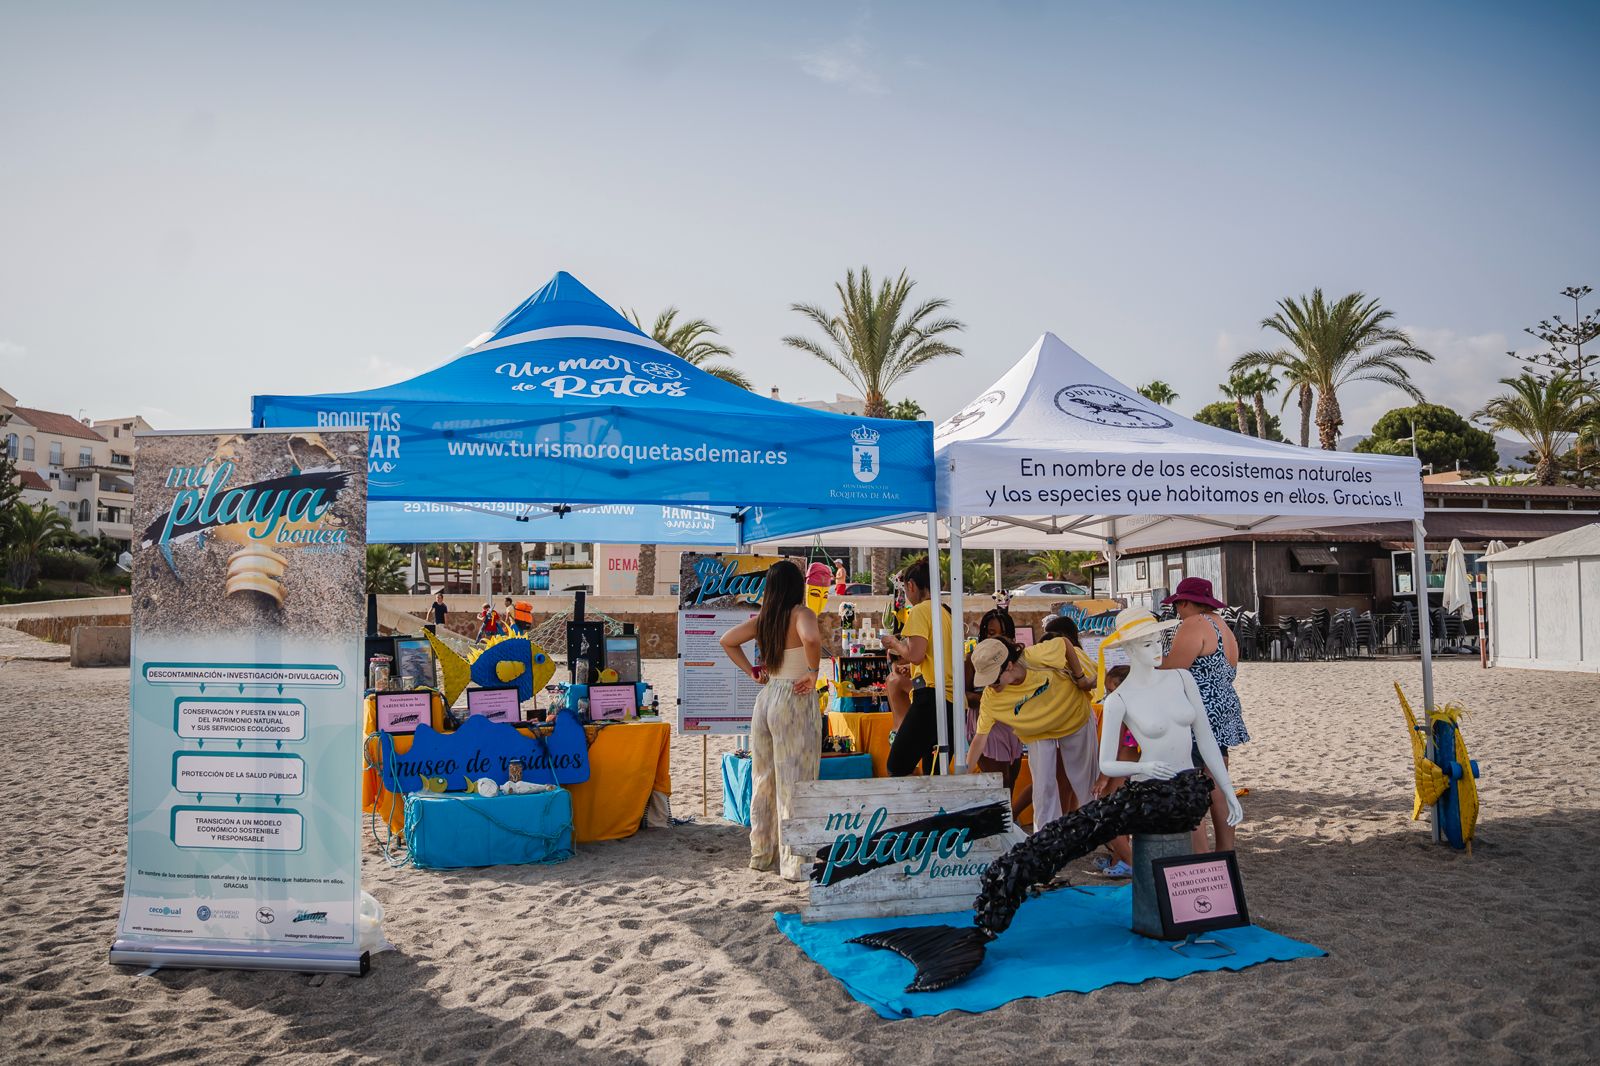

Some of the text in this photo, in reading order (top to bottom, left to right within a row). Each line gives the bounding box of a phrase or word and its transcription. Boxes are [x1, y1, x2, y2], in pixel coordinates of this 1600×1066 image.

[495, 355, 635, 378] Un mar
[511, 374, 691, 398] de Rutas
[1065, 388, 1127, 402] Objetivo
[447, 438, 788, 465] www.turismoroquetasdemar.es
[165, 456, 214, 488] mi
[1020, 458, 1372, 483] En nombre de los ecosistemas naturales
[159, 461, 330, 545] playa
[985, 489, 997, 507] y
[1002, 485, 1032, 502] las
[1038, 485, 1121, 507] especies
[1127, 489, 1161, 507] que
[1166, 485, 1259, 503] habitamos
[1263, 490, 1284, 504] en
[1288, 487, 1329, 505] ellos.
[1333, 489, 1392, 507] Gracias
[695, 559, 767, 606] play
[148, 670, 339, 680] DESCONTAMINACIÓN INVESTIGACIÓN DIVULGACIÓN
[247, 725, 290, 733] ECOLÓGICOS
[268, 771, 298, 779] PÚBLICA
[389, 759, 459, 779] museo
[466, 749, 491, 774] de
[195, 817, 235, 825] TRANSICIÓN
[197, 825, 237, 833] ECONÓMICO
[825, 804, 866, 831] mi
[820, 806, 974, 886] playa
[1171, 874, 1225, 890] QUIERO CONTARTE
[1171, 889, 1188, 897] ALGO
